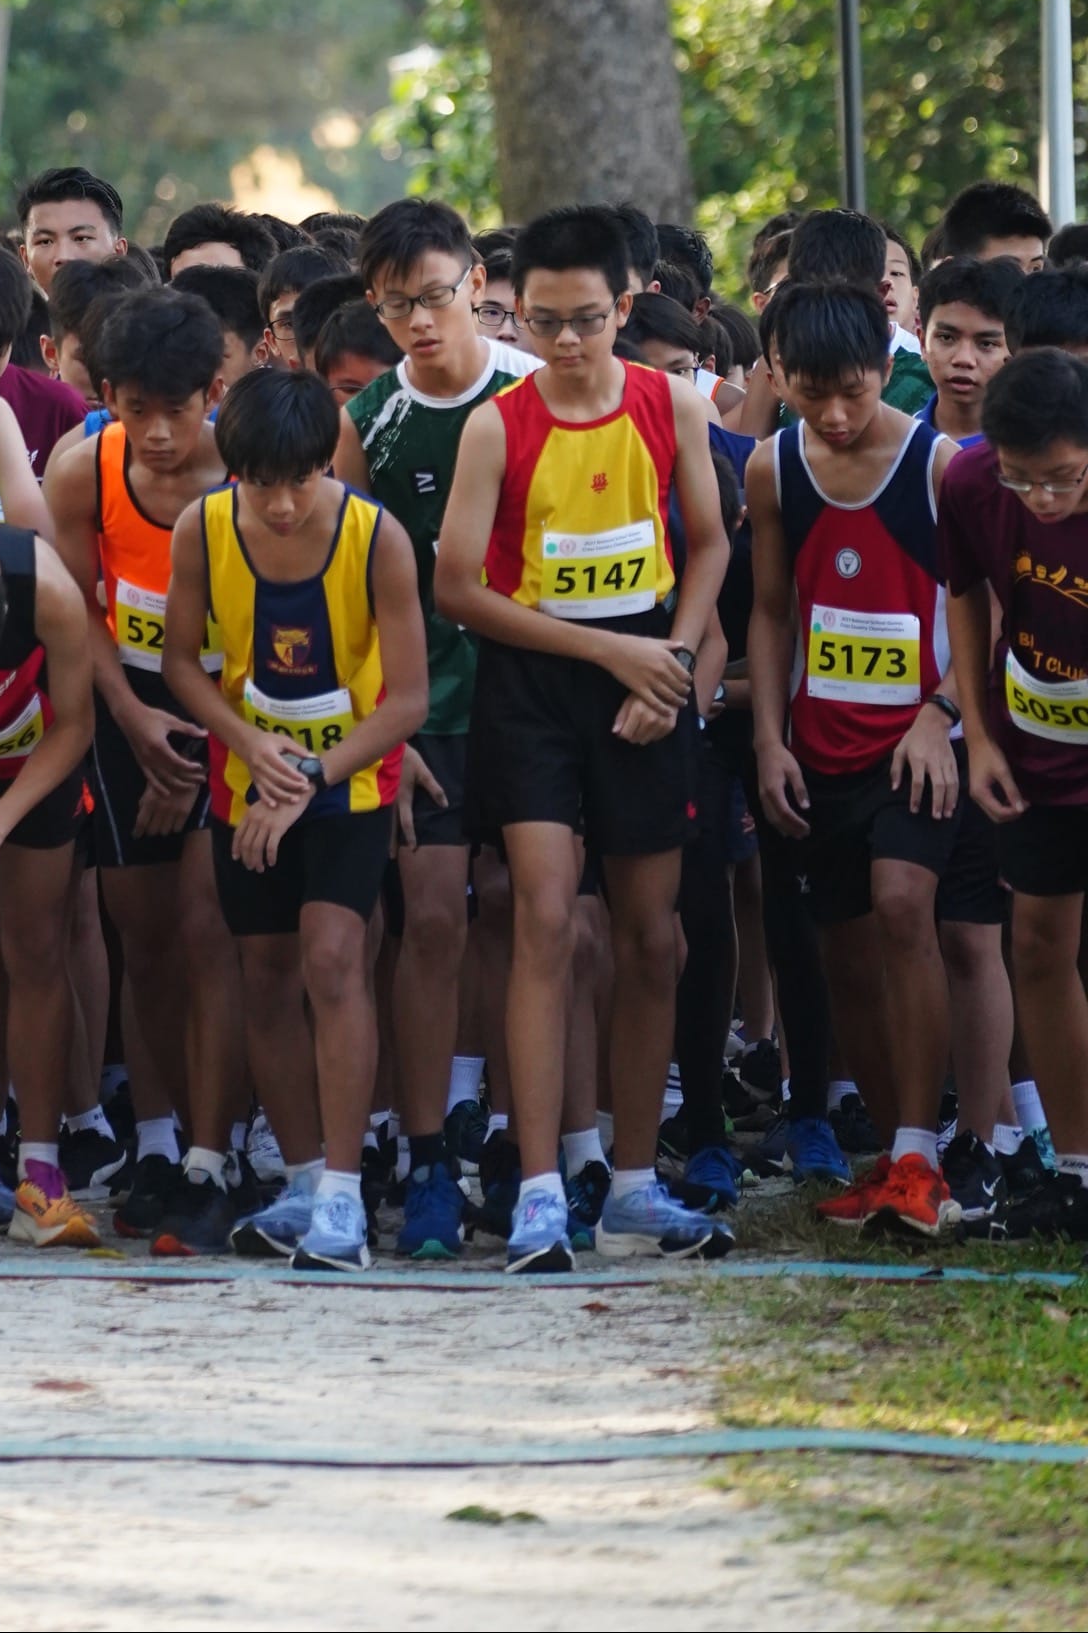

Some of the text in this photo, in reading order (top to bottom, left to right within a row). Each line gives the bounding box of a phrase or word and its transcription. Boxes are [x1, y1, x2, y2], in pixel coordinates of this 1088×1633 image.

[553, 556, 646, 595] 5147
[817, 640, 908, 679] 5173
[1013, 687, 1088, 727] 5050
